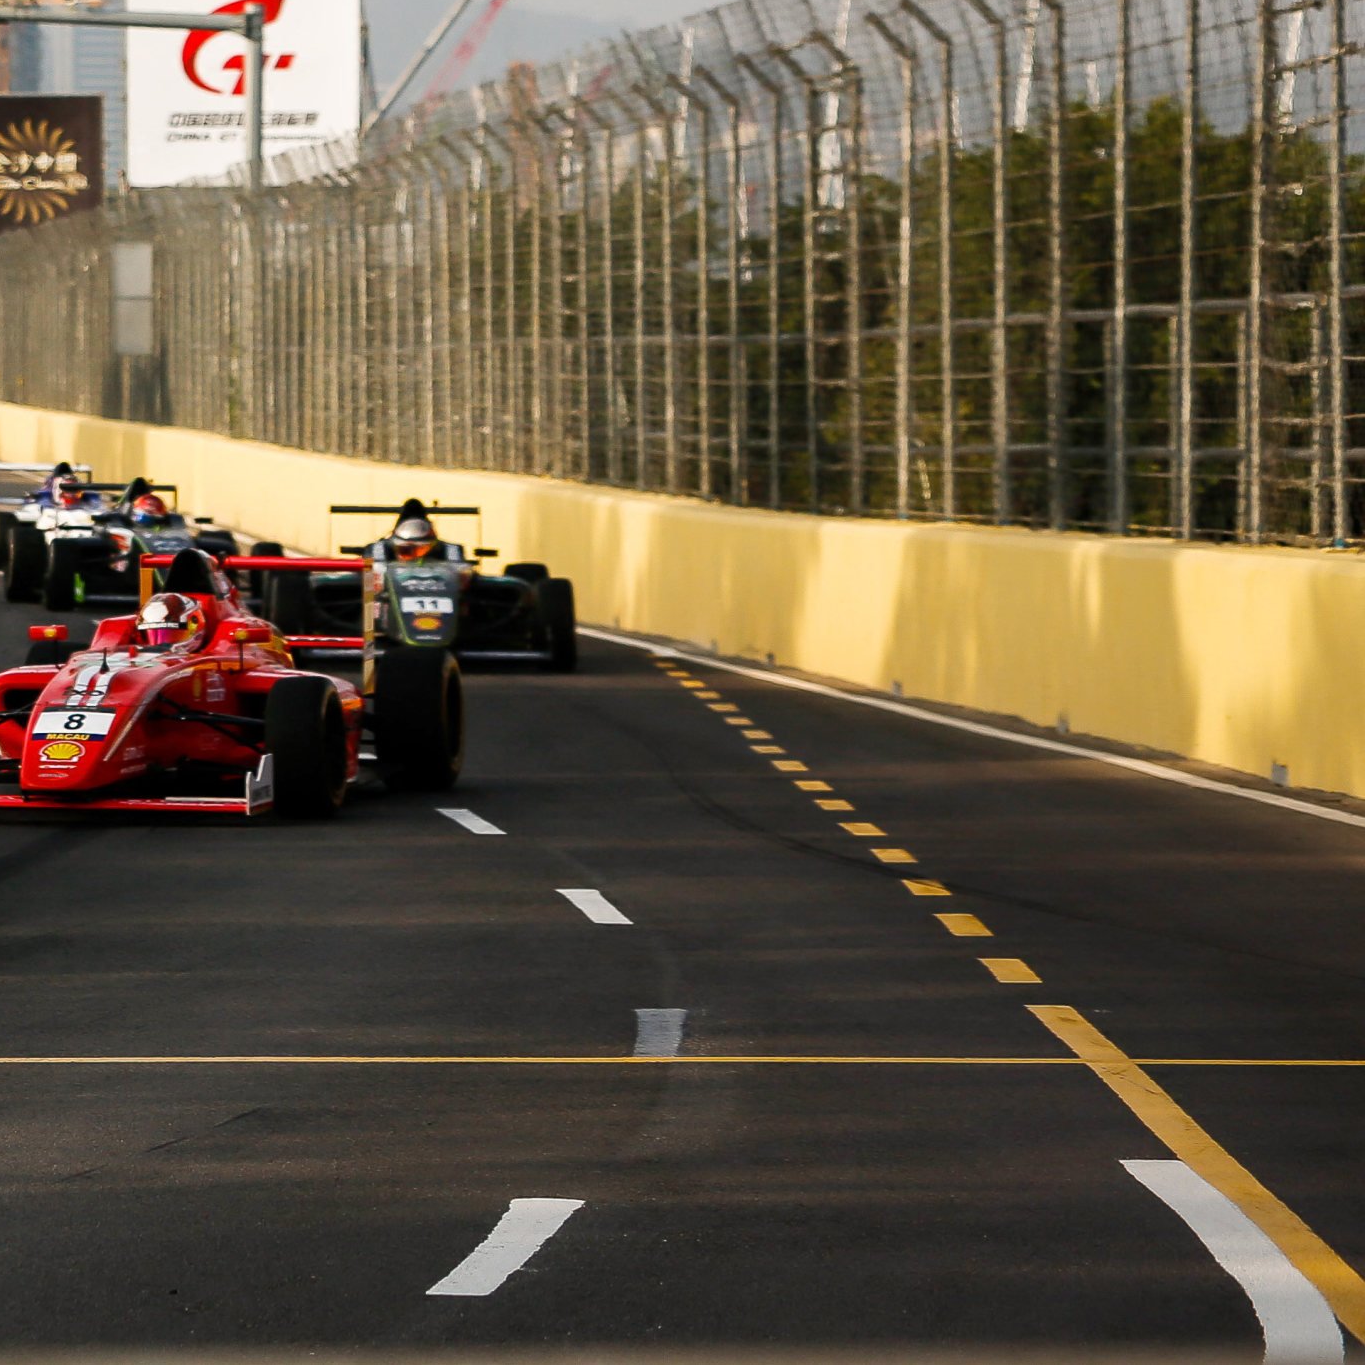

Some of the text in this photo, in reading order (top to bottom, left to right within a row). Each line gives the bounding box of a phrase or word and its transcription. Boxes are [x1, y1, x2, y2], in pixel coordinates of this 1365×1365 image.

[415, 599, 439, 610] 11
[63, 714, 87, 731] 8
[46, 733, 90, 741] MACAU
